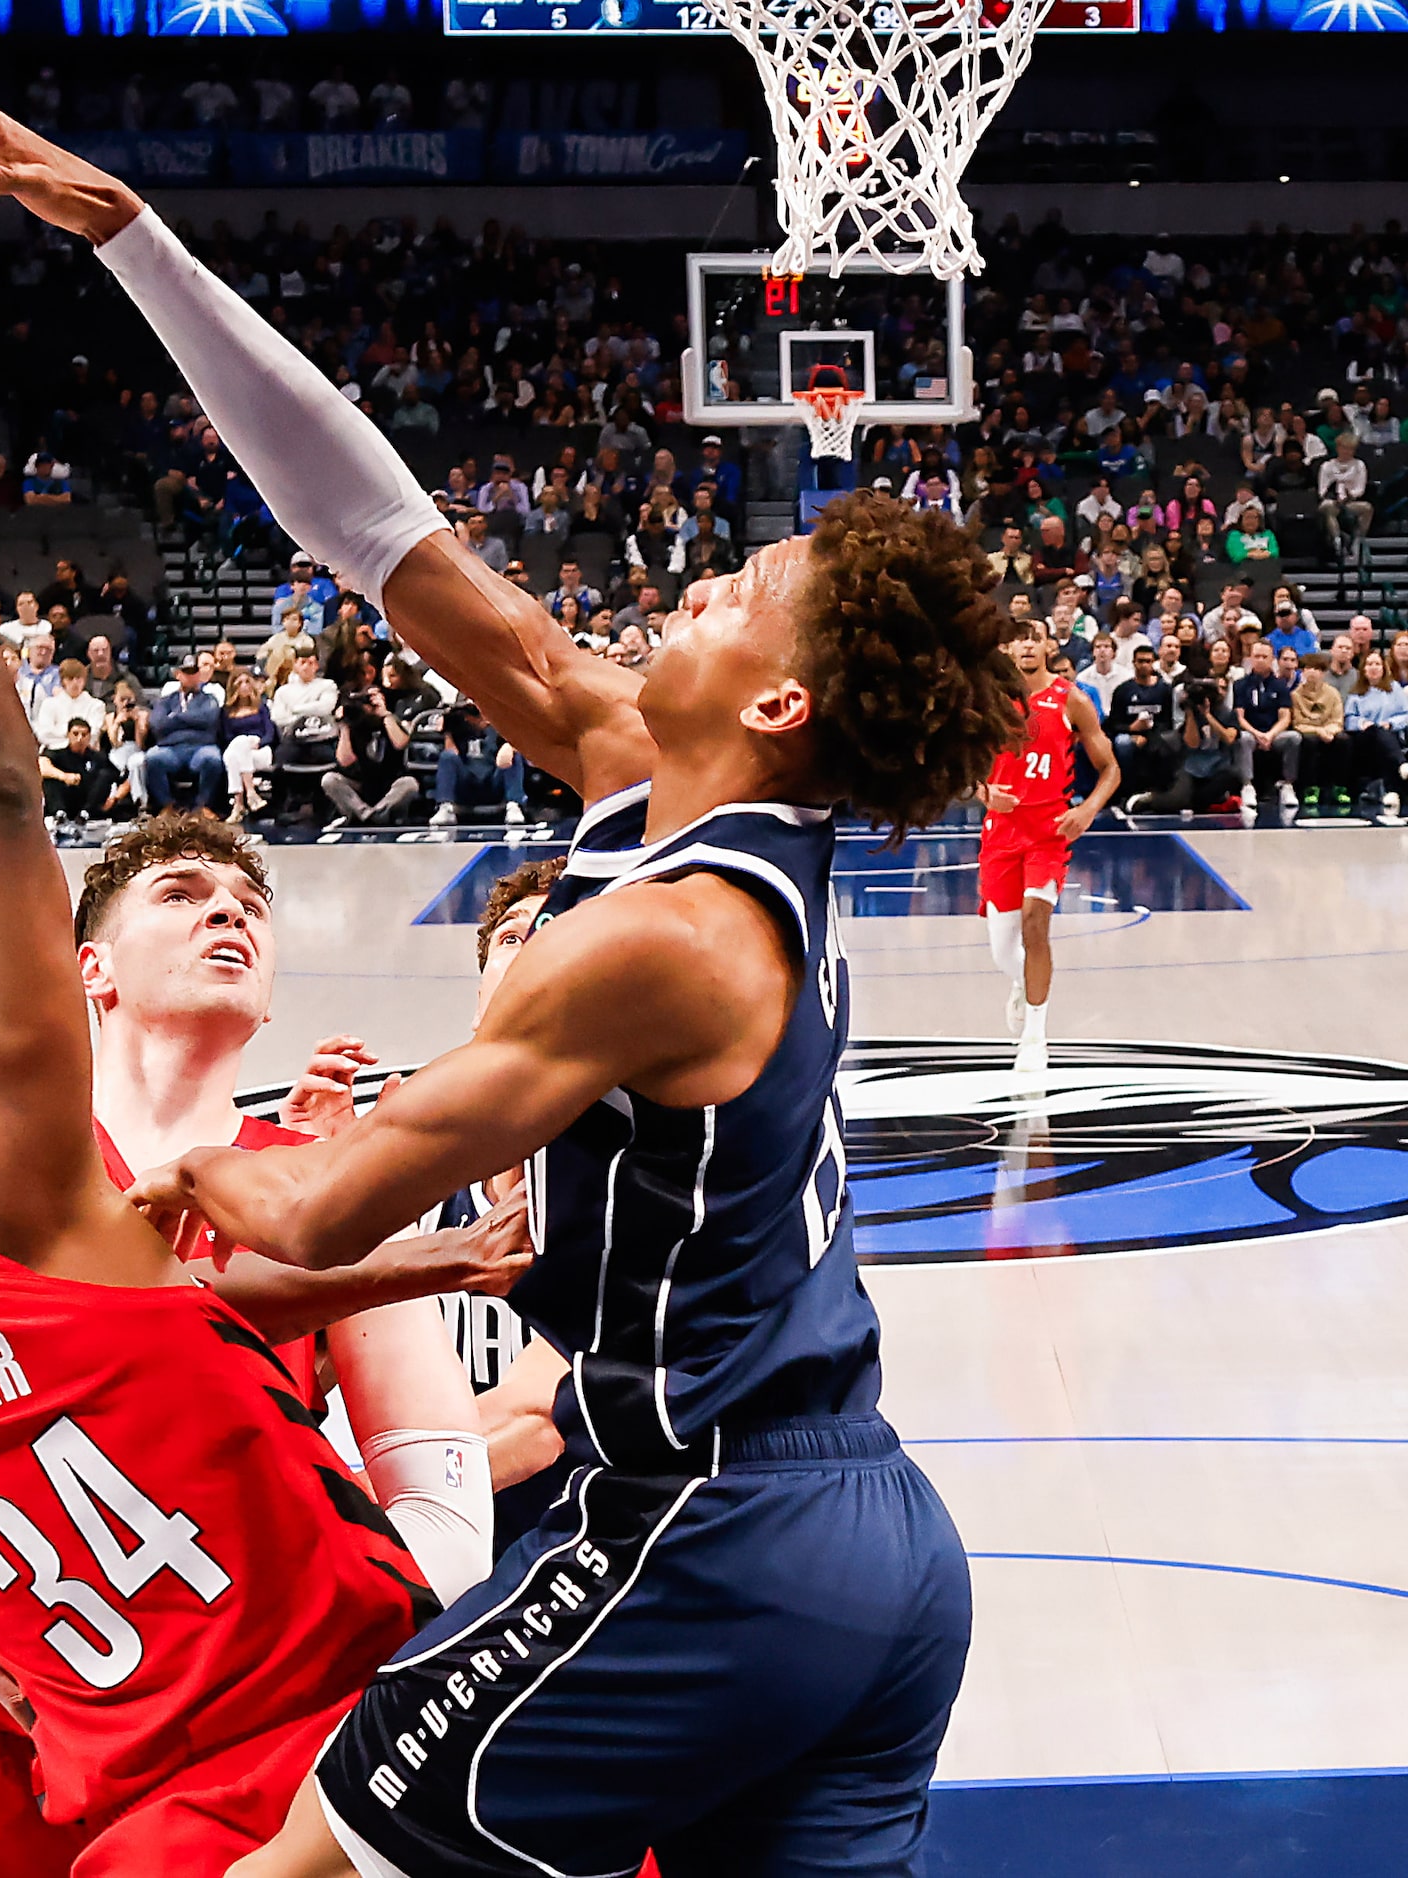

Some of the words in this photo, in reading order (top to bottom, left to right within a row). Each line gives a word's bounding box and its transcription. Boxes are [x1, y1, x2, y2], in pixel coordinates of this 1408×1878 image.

[480, 8, 497, 28] 4
[551, 8, 567, 28] 5
[1084, 6, 1101, 28] 3
[1024, 752, 1051, 780] 24
[367, 1539, 610, 1810] MAVERICKS
